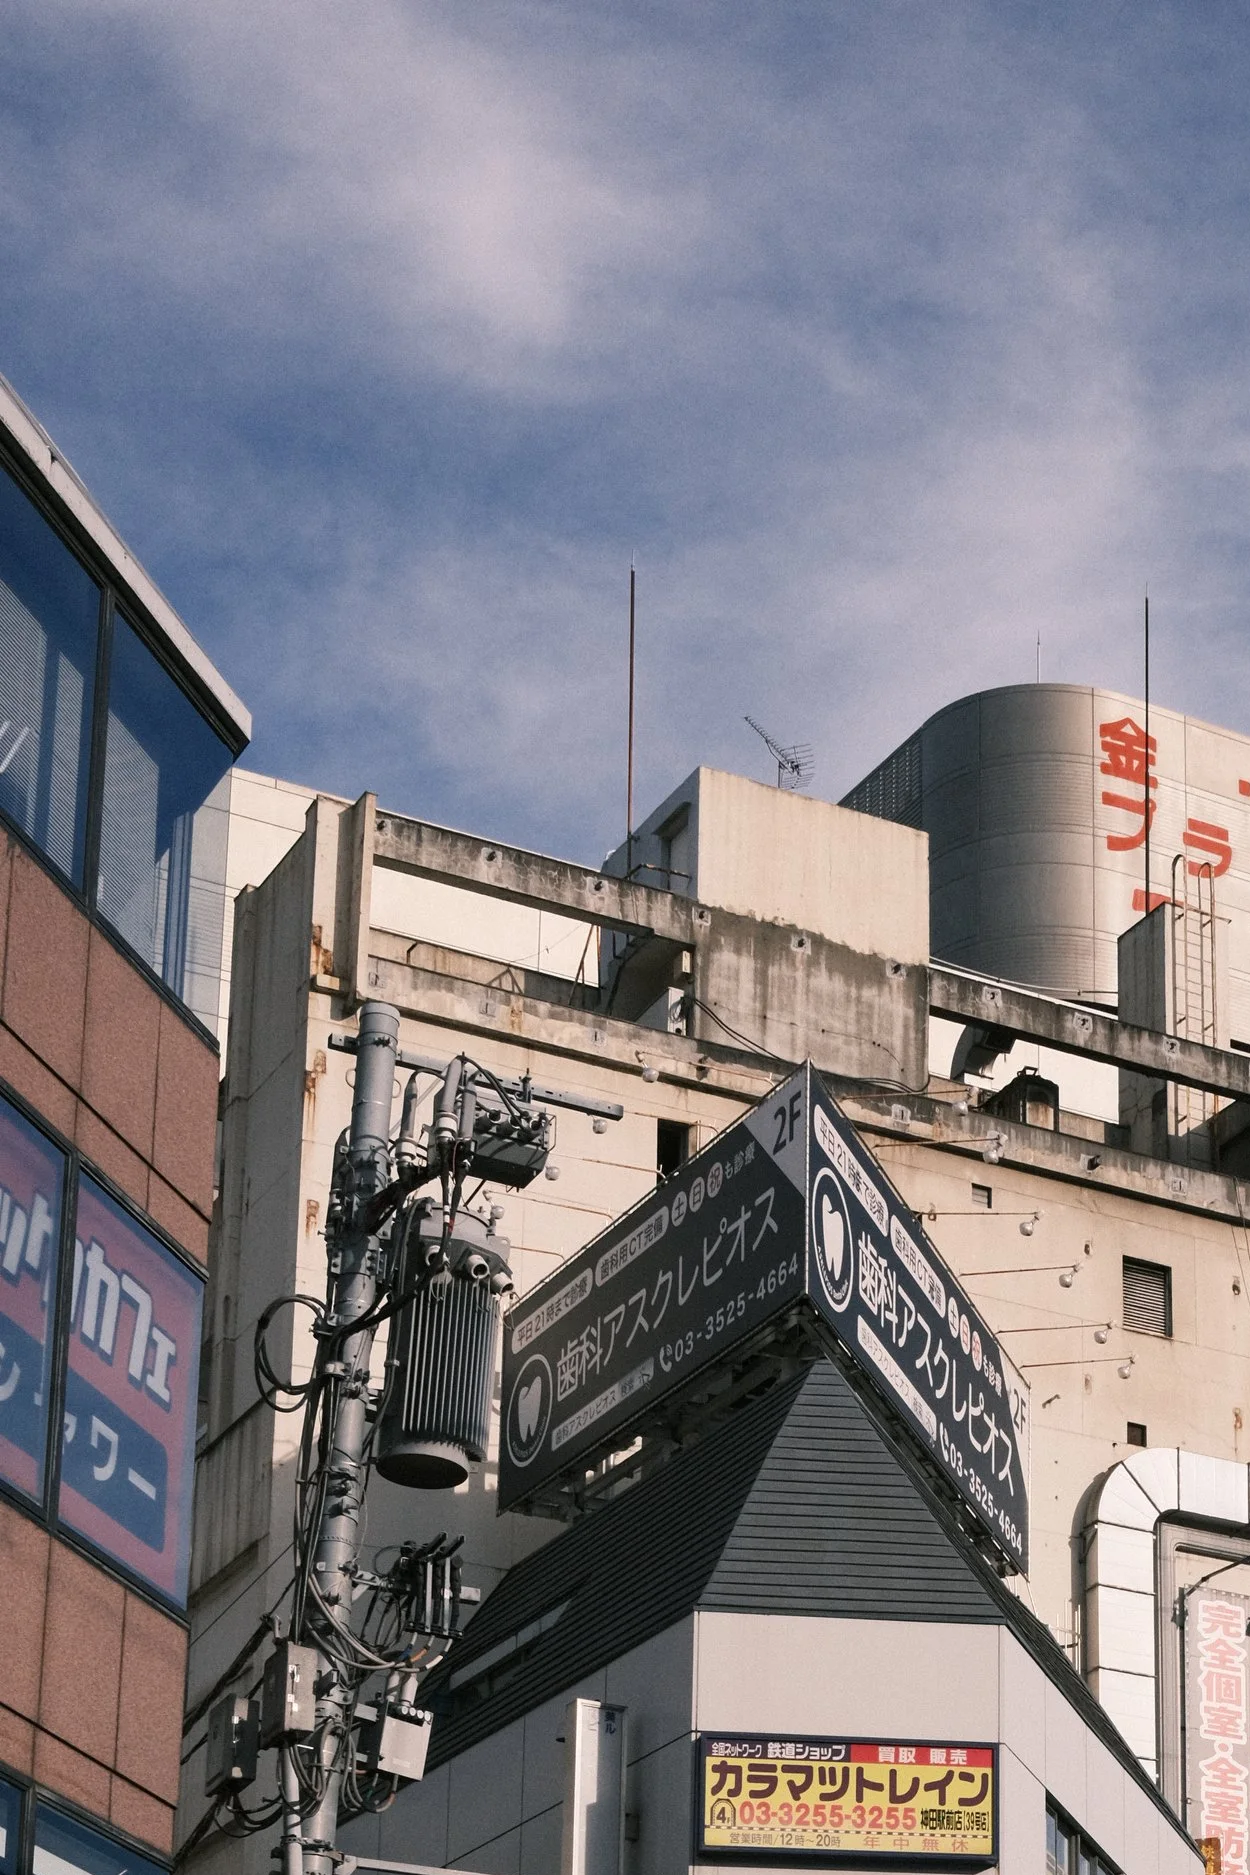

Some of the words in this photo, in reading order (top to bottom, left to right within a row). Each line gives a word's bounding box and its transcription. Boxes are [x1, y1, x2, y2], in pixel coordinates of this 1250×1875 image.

[772, 1091, 802, 1157] 2F
[556, 1186, 779, 1402] 歯科アスクレピオス
[674, 1251, 799, 1362] 03-3525-4664
[858, 1231, 1015, 1496] 歯科アスクレピオス
[1013, 1388, 1027, 1433] 2F
[949, 1447, 1024, 1556] 03-3525-4664
[711, 1742, 763, 1758] 全国ネットワーク
[766, 1742, 846, 1761] 鉄道ショップ
[877, 1746, 917, 1764] 買取
[929, 1747, 968, 1766] 販売
[709, 1760, 990, 1807] カラマツトレイン
[738, 1800, 918, 1831] 03-3255-3255
